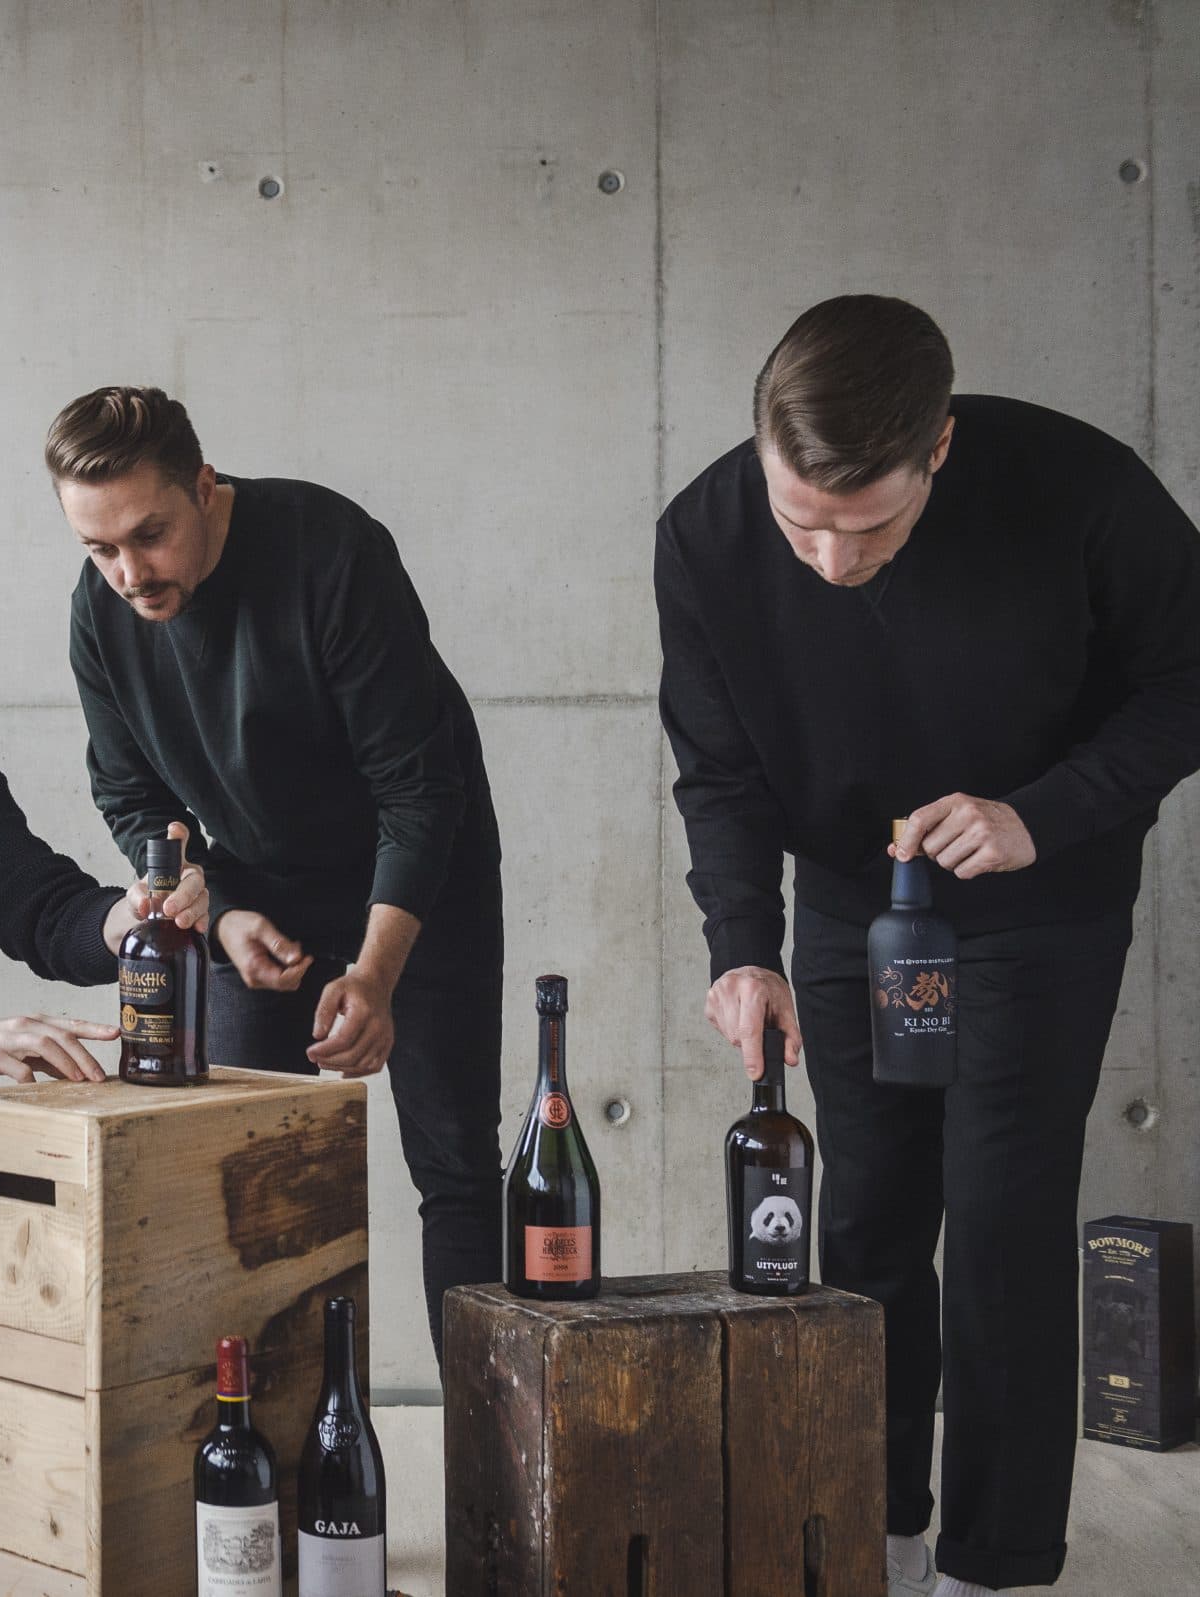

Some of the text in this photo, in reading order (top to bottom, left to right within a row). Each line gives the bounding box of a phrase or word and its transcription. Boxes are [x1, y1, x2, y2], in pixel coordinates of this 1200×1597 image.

[904, 1016, 950, 1027] KI NO BI
[1088, 1237, 1151, 1258] BOWMORE
[1114, 1378, 1125, 1386] 23
[314, 1519, 362, 1536] GAJA
